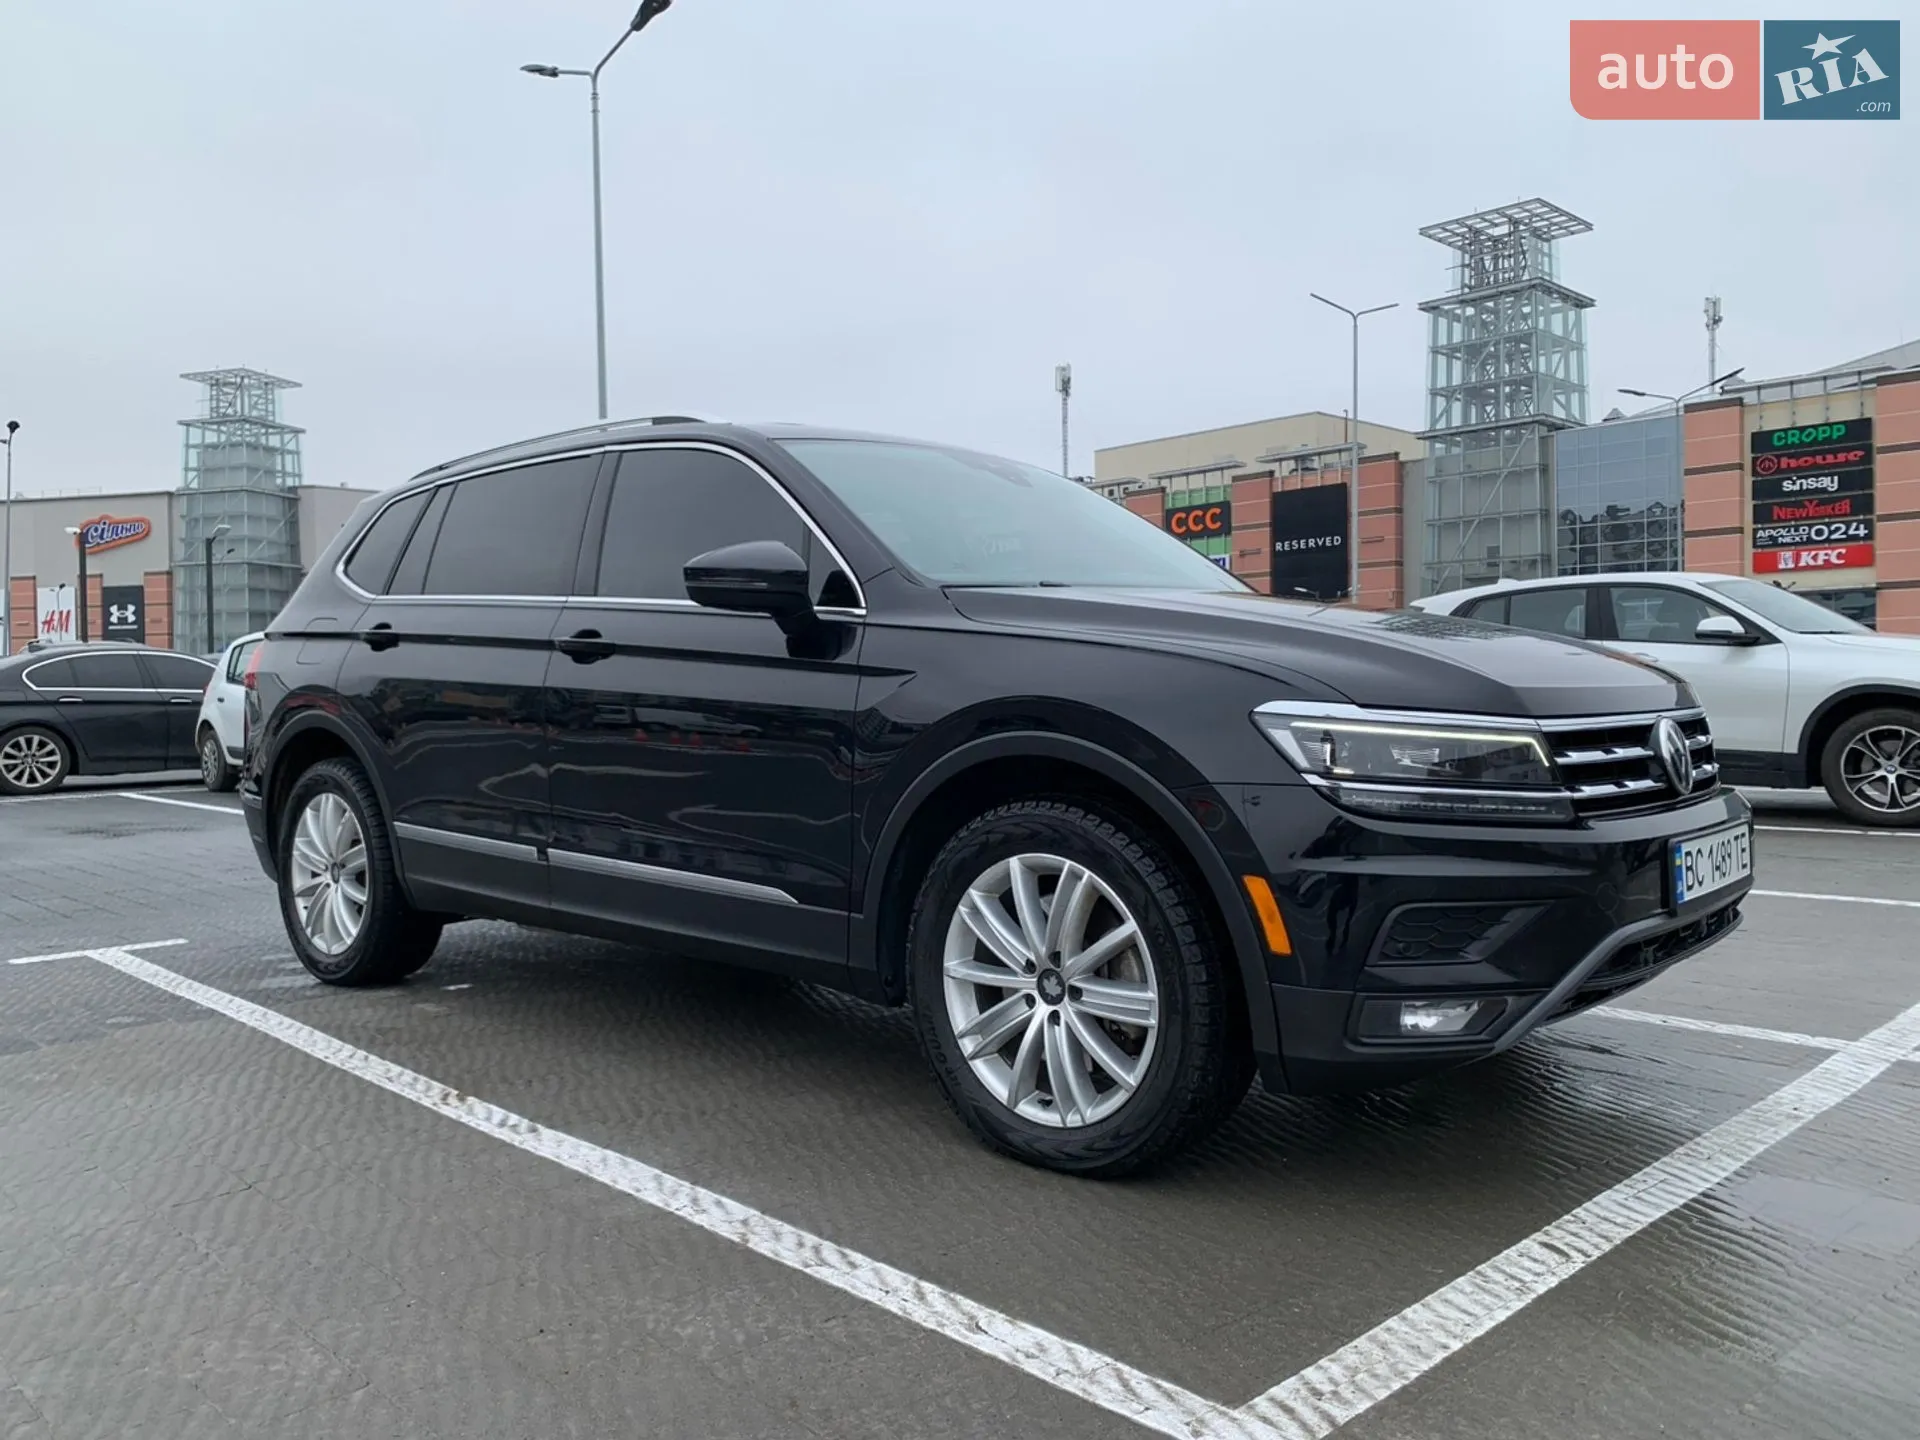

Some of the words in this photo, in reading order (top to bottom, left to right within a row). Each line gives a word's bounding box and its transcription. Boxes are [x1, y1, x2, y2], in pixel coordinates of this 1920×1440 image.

[1772, 424, 1846, 447] CROPP
[1782, 475, 1839, 491] sinsay
[1171, 507, 1223, 534] CCC
[1756, 526, 1809, 539] APOLLO
[1778, 535, 1809, 544] NEXT
[1275, 535, 1342, 552] RESERVED
[1798, 548, 1847, 567] KFC
[1684, 847, 1705, 892] BC
[1708, 838, 1732, 883] 1489
[1733, 832, 1748, 873] TE
